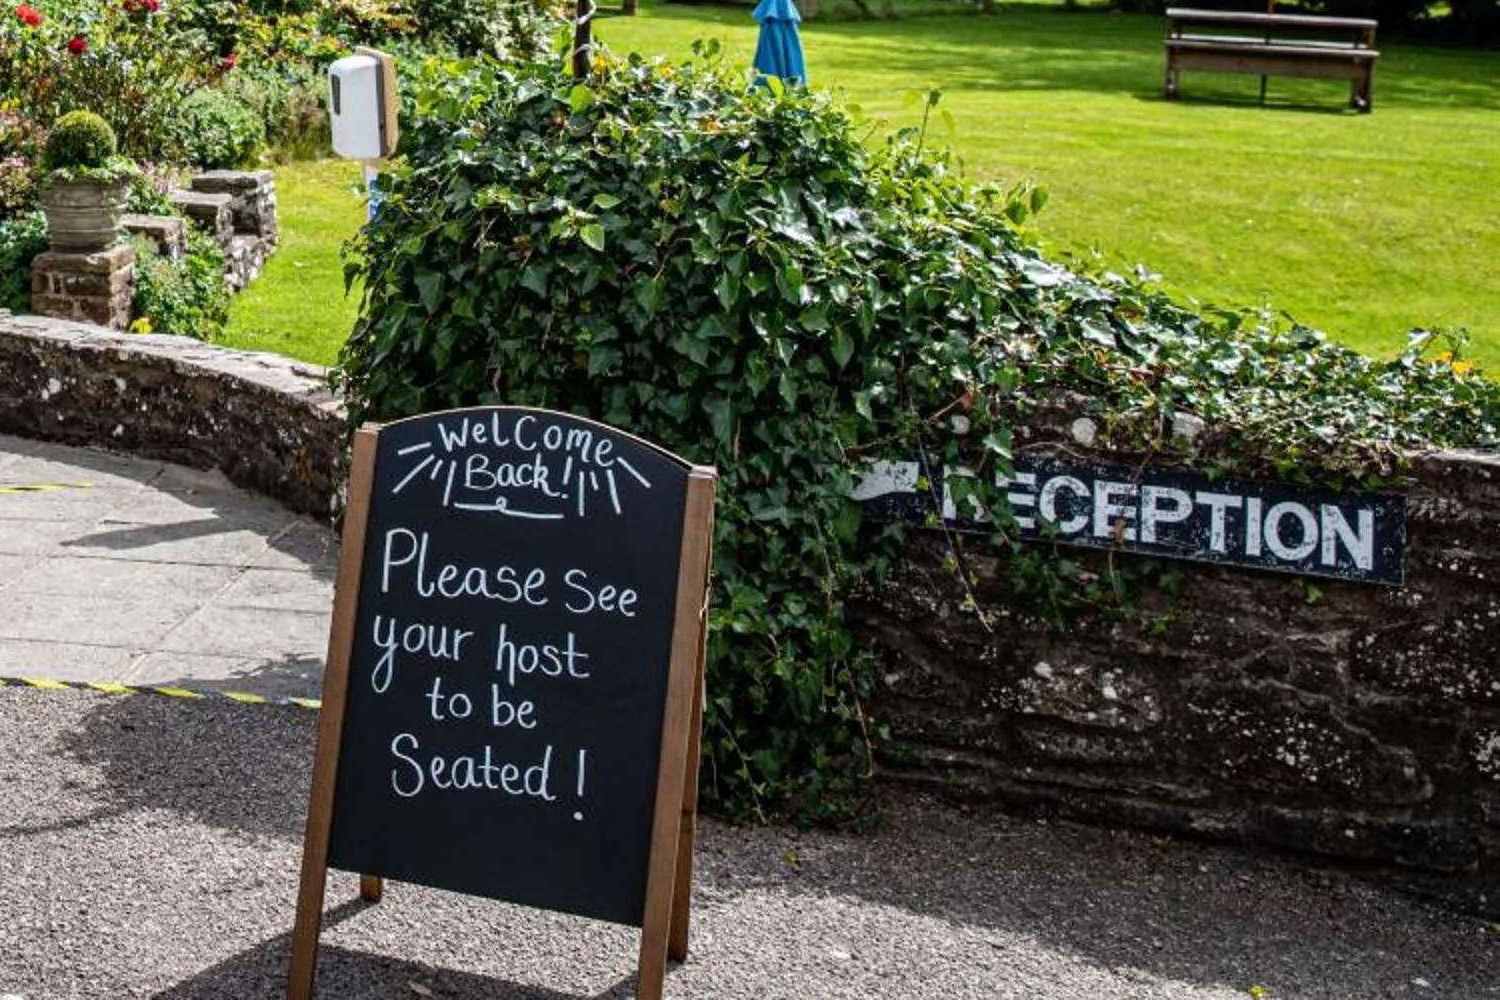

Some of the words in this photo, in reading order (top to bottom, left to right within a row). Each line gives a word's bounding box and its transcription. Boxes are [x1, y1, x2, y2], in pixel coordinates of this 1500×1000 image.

[381, 527, 548, 604] Please
[371, 615, 475, 693] your
[496, 624, 590, 686] host
[426, 677, 473, 720] to
[492, 683, 537, 729] be
